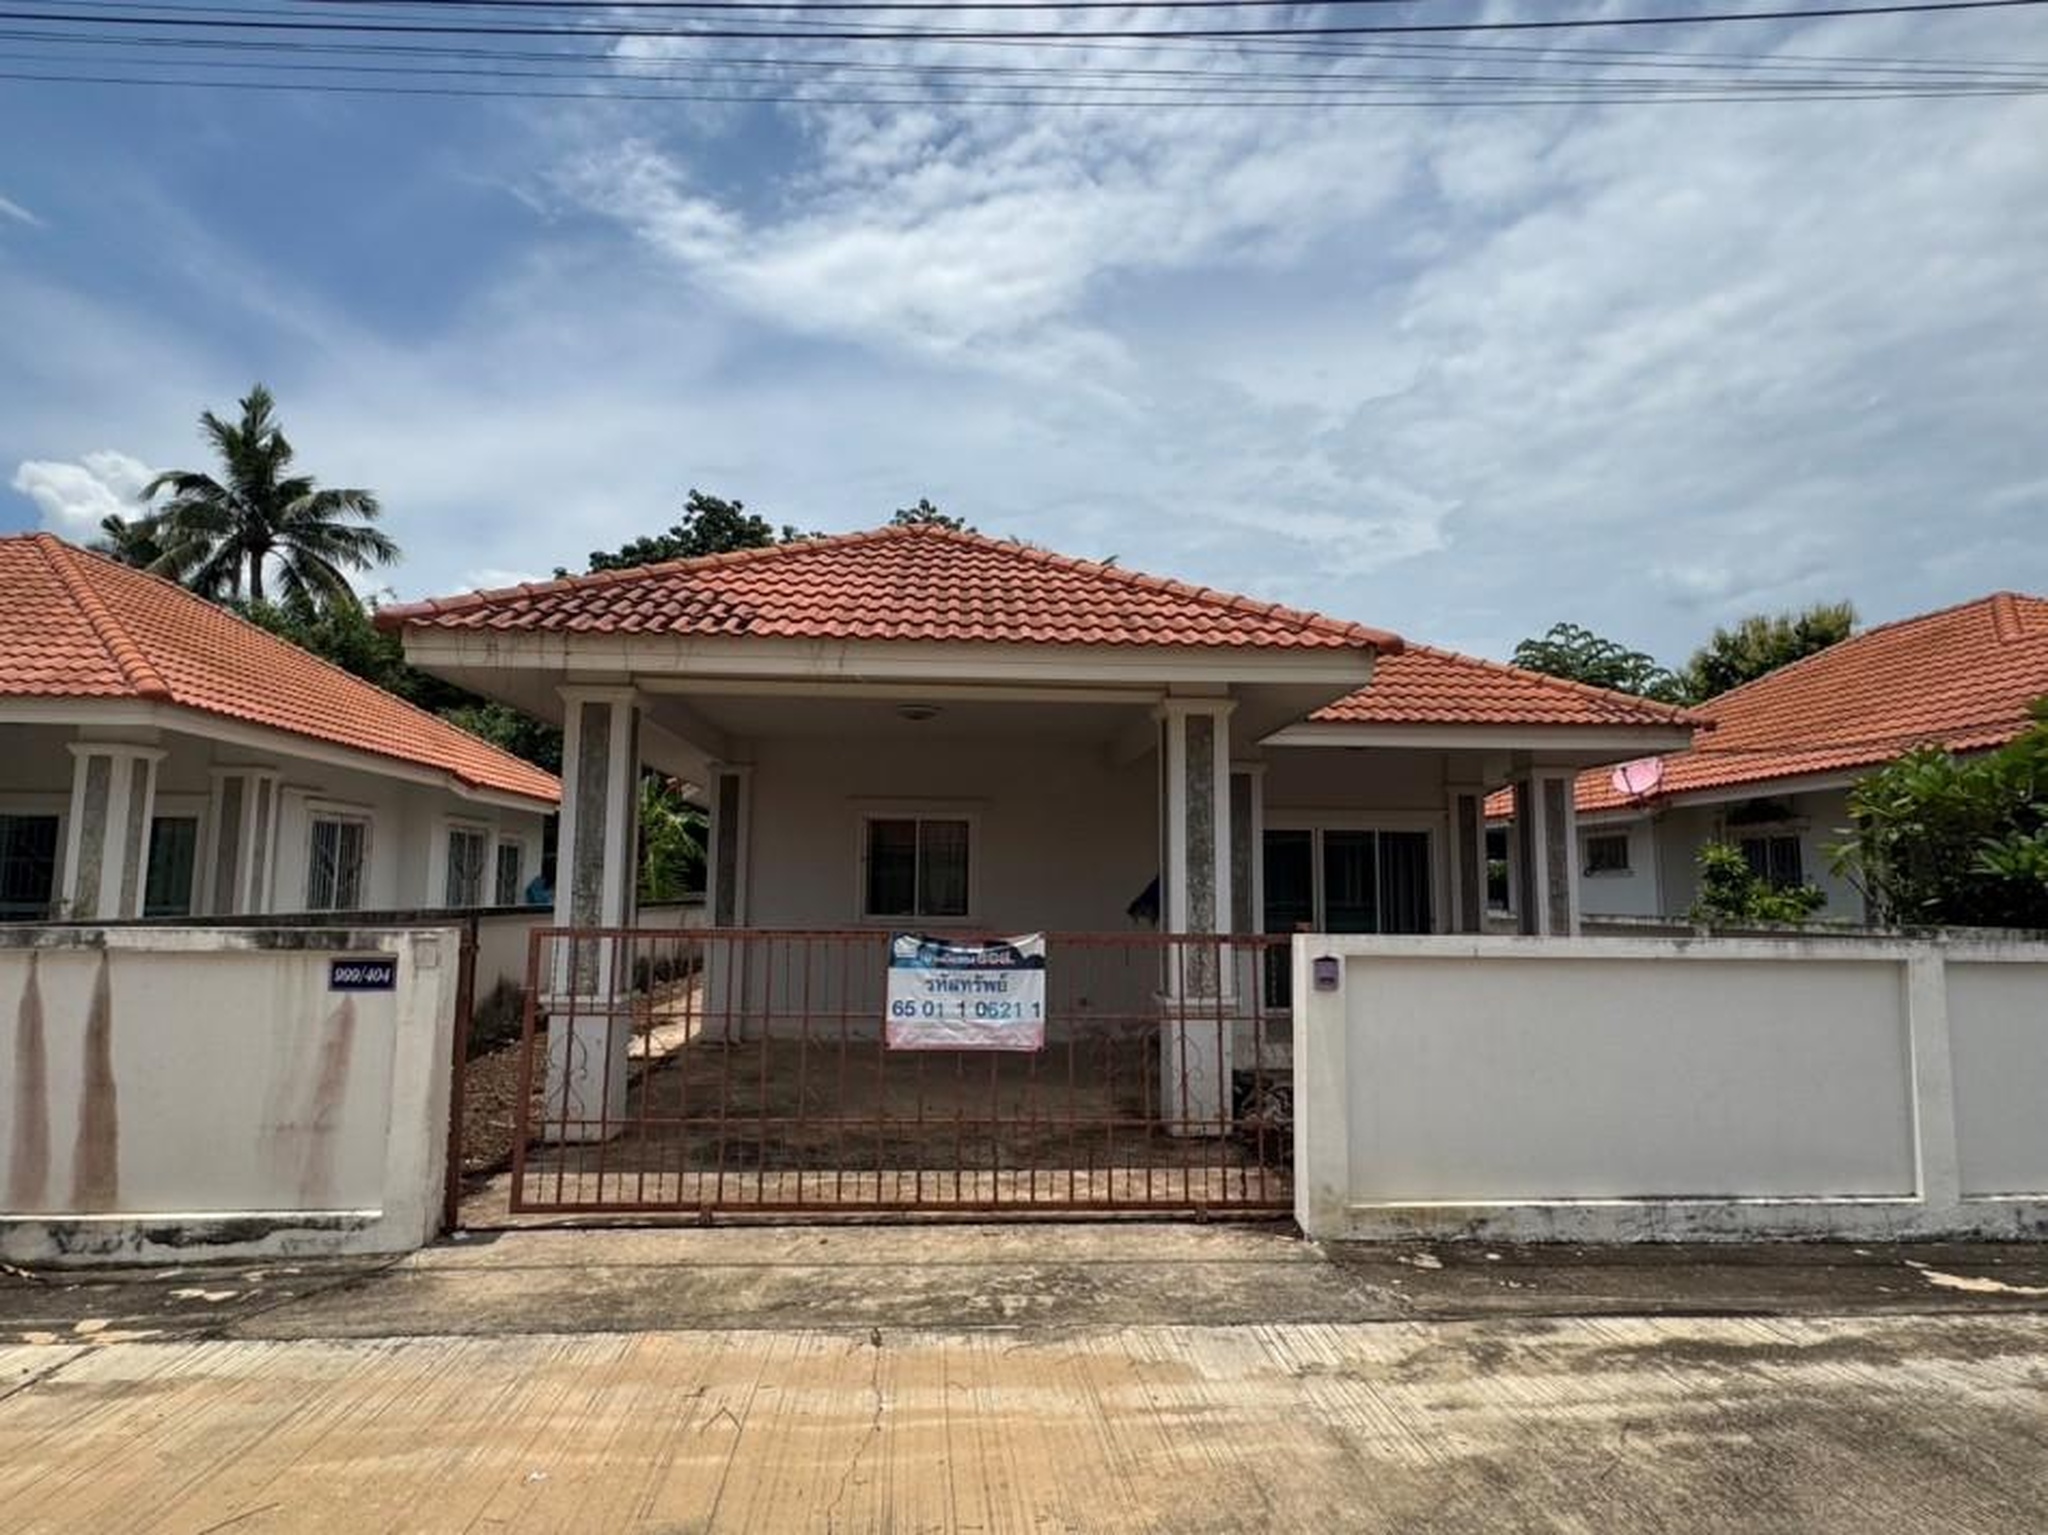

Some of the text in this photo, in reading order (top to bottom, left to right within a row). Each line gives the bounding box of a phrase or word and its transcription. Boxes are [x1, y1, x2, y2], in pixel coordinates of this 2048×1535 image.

[334, 967, 391, 983] 999/404
[892, 1000, 916, 1016] 65
[922, 1000, 944, 1017] 01
[1031, 1001, 1041, 1017] 1
